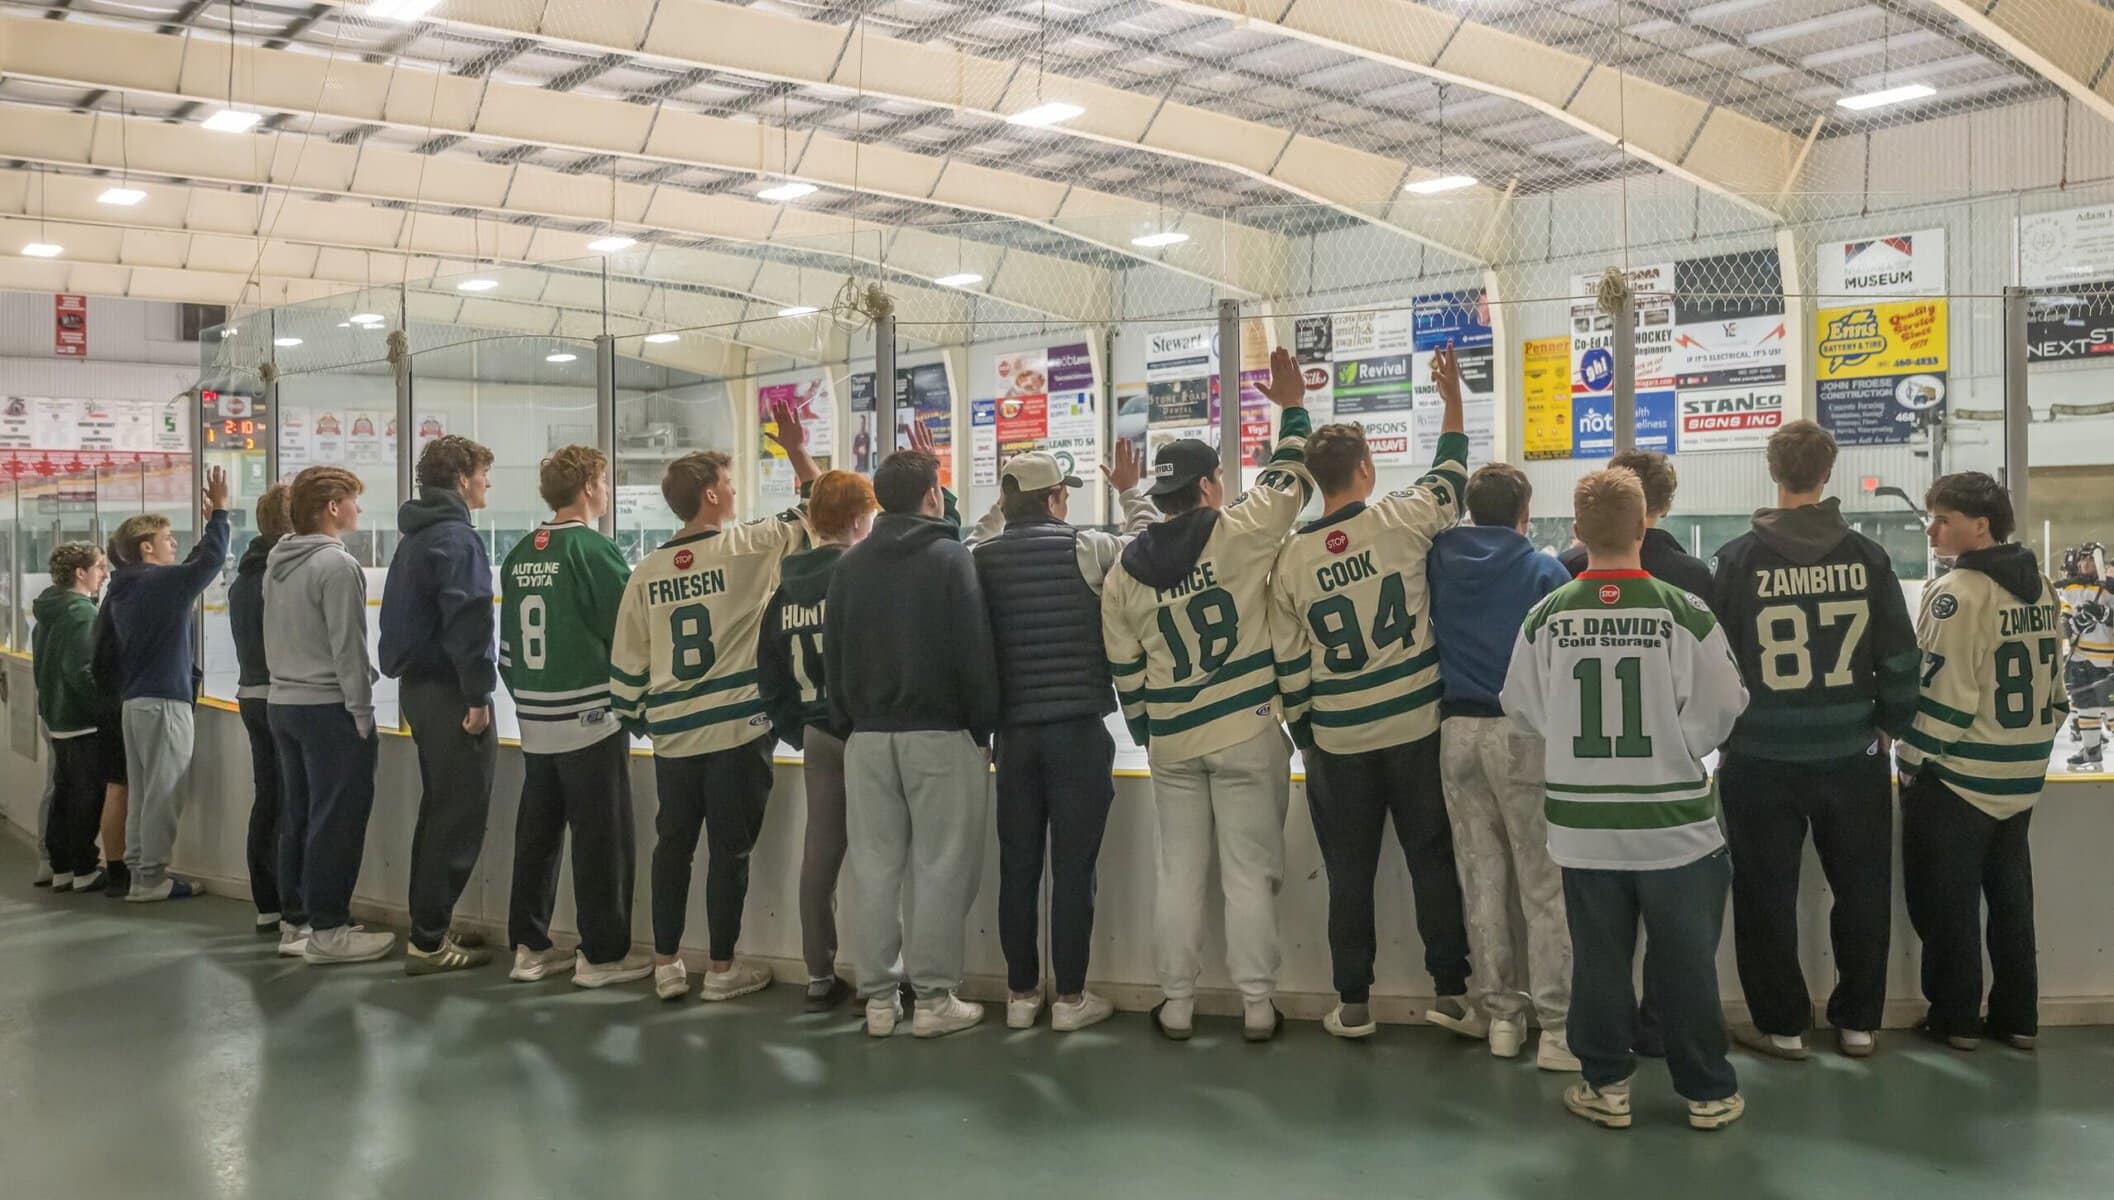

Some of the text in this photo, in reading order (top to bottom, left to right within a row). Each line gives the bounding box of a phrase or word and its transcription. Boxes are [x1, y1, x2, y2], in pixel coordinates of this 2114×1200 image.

[1844, 270, 1913, 289] MUSEUM
[1635, 330, 1672, 344] HOCKEY
[1830, 323, 1877, 340] Enns
[1152, 333, 1202, 354] Stewart
[1524, 341, 1569, 354] Penner
[1574, 337, 1601, 350] Co-Ed
[1823, 343, 1857, 352] BATTERY
[1865, 340, 1882, 349] TIRE
[2027, 338, 2090, 359] NEXT
[1359, 359, 1407, 379] Revival
[1820, 388, 1893, 400] CONSTRUCTION
[1821, 378, 1893, 391] JOHN FROESE
[1580, 413, 1613, 433] not
[1636, 419, 1668, 430] ellness
[1687, 414, 1777, 430] SIGNS INC
[1049, 440, 1073, 449] LEARN
[1326, 535, 1348, 550] STOP
[674, 554, 694, 565] STOP
[1316, 550, 1378, 593] COOK
[1756, 563, 1868, 598] ZAMBITO
[648, 568, 726, 605] FRIESEN
[1307, 571, 1417, 673] 94
[1550, 617, 1673, 639] ST. DAVID'S
[520, 594, 547, 670] 8
[1156, 587, 1240, 683] 18
[670, 602, 716, 682] 8
[1558, 636, 1662, 648] Cold Storage
[1756, 600, 1871, 691] 87
[1573, 656, 1653, 758] 11
